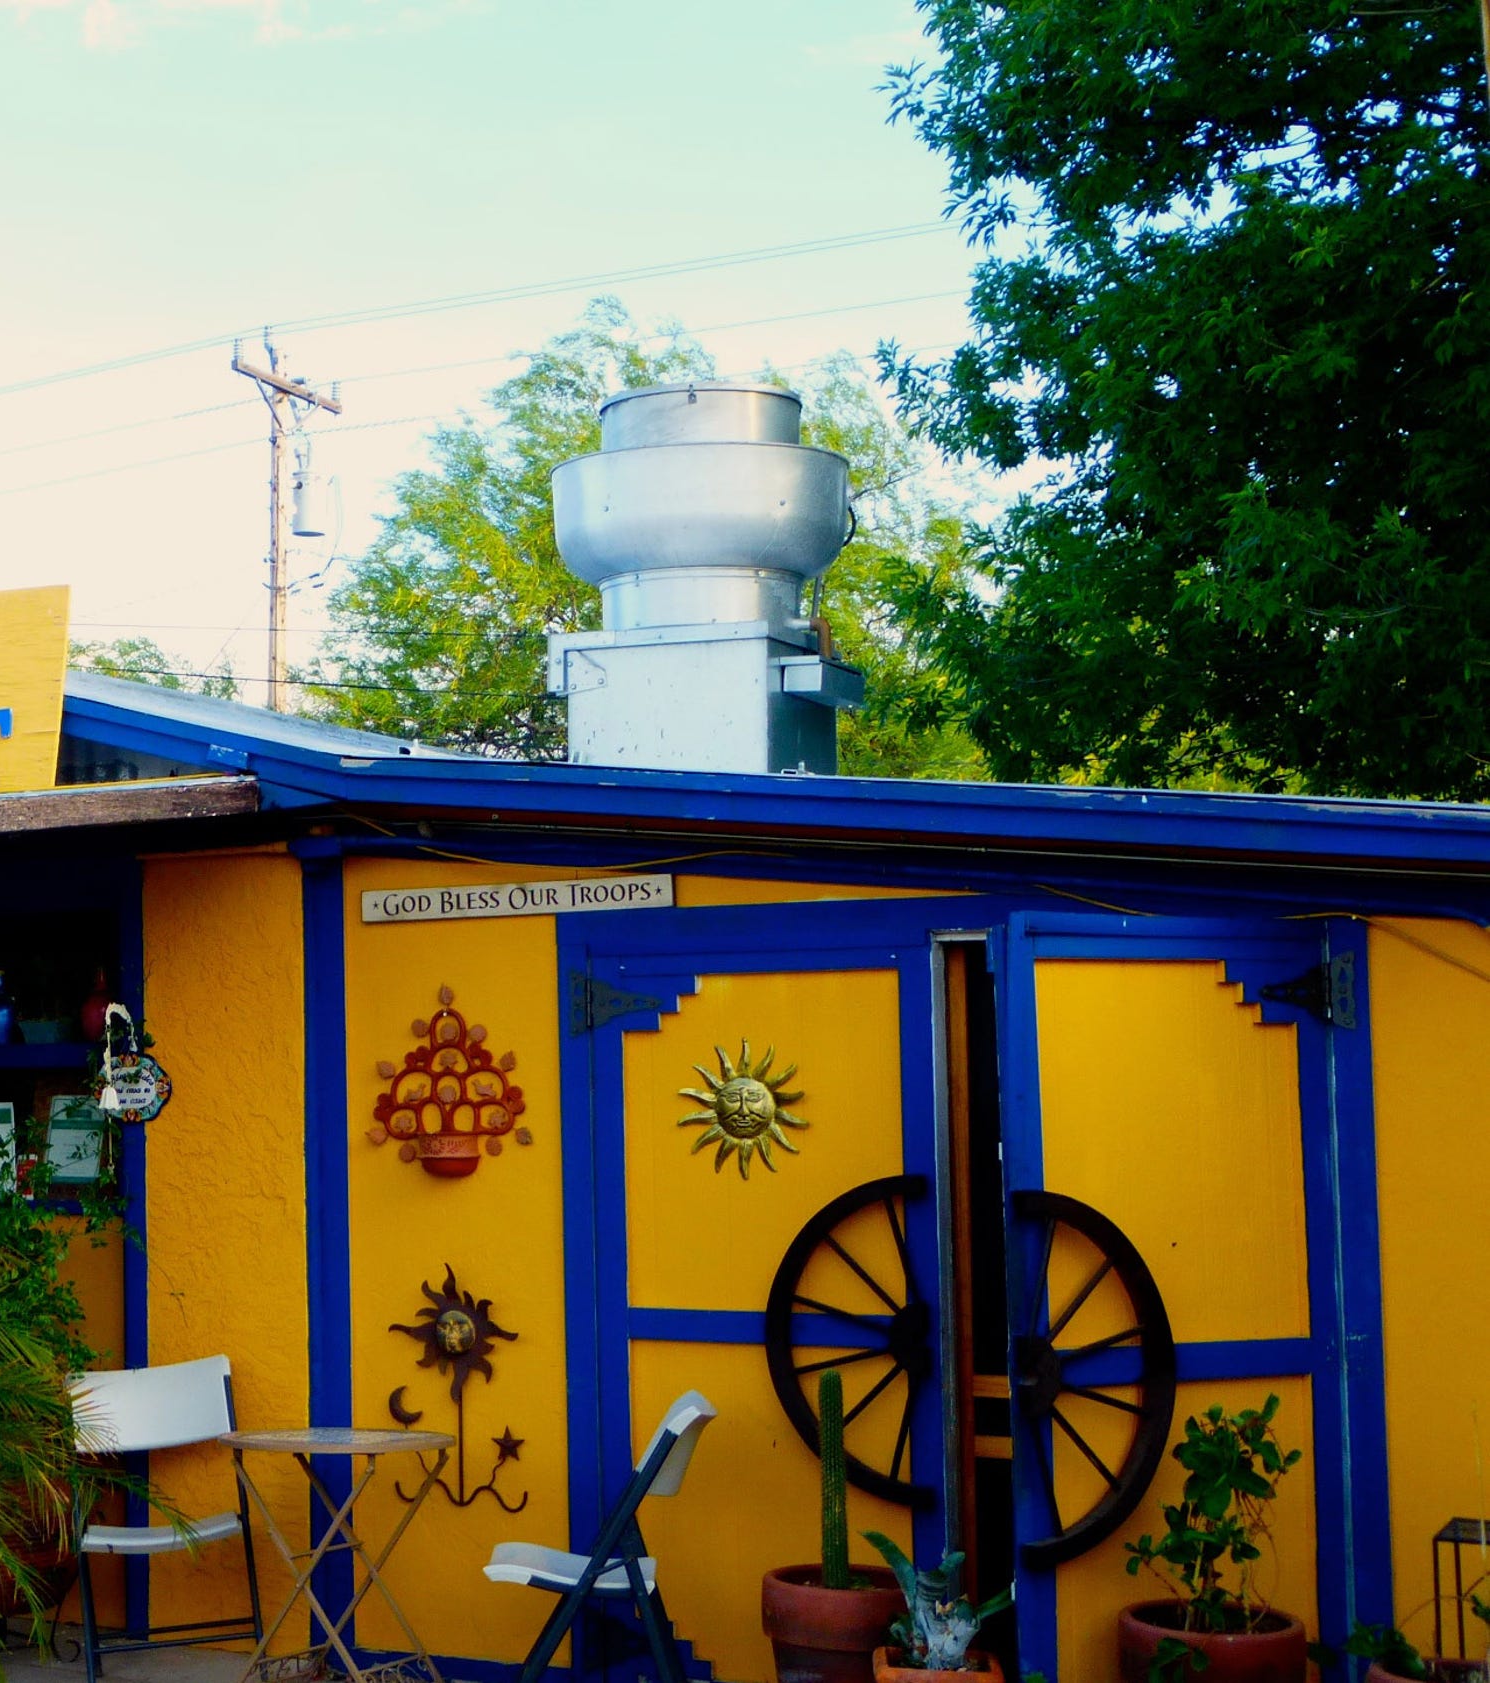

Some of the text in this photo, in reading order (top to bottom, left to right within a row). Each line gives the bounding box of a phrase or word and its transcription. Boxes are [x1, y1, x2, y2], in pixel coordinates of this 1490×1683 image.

[382, 881, 652, 917] GOD BLESS OUR TROOPS
